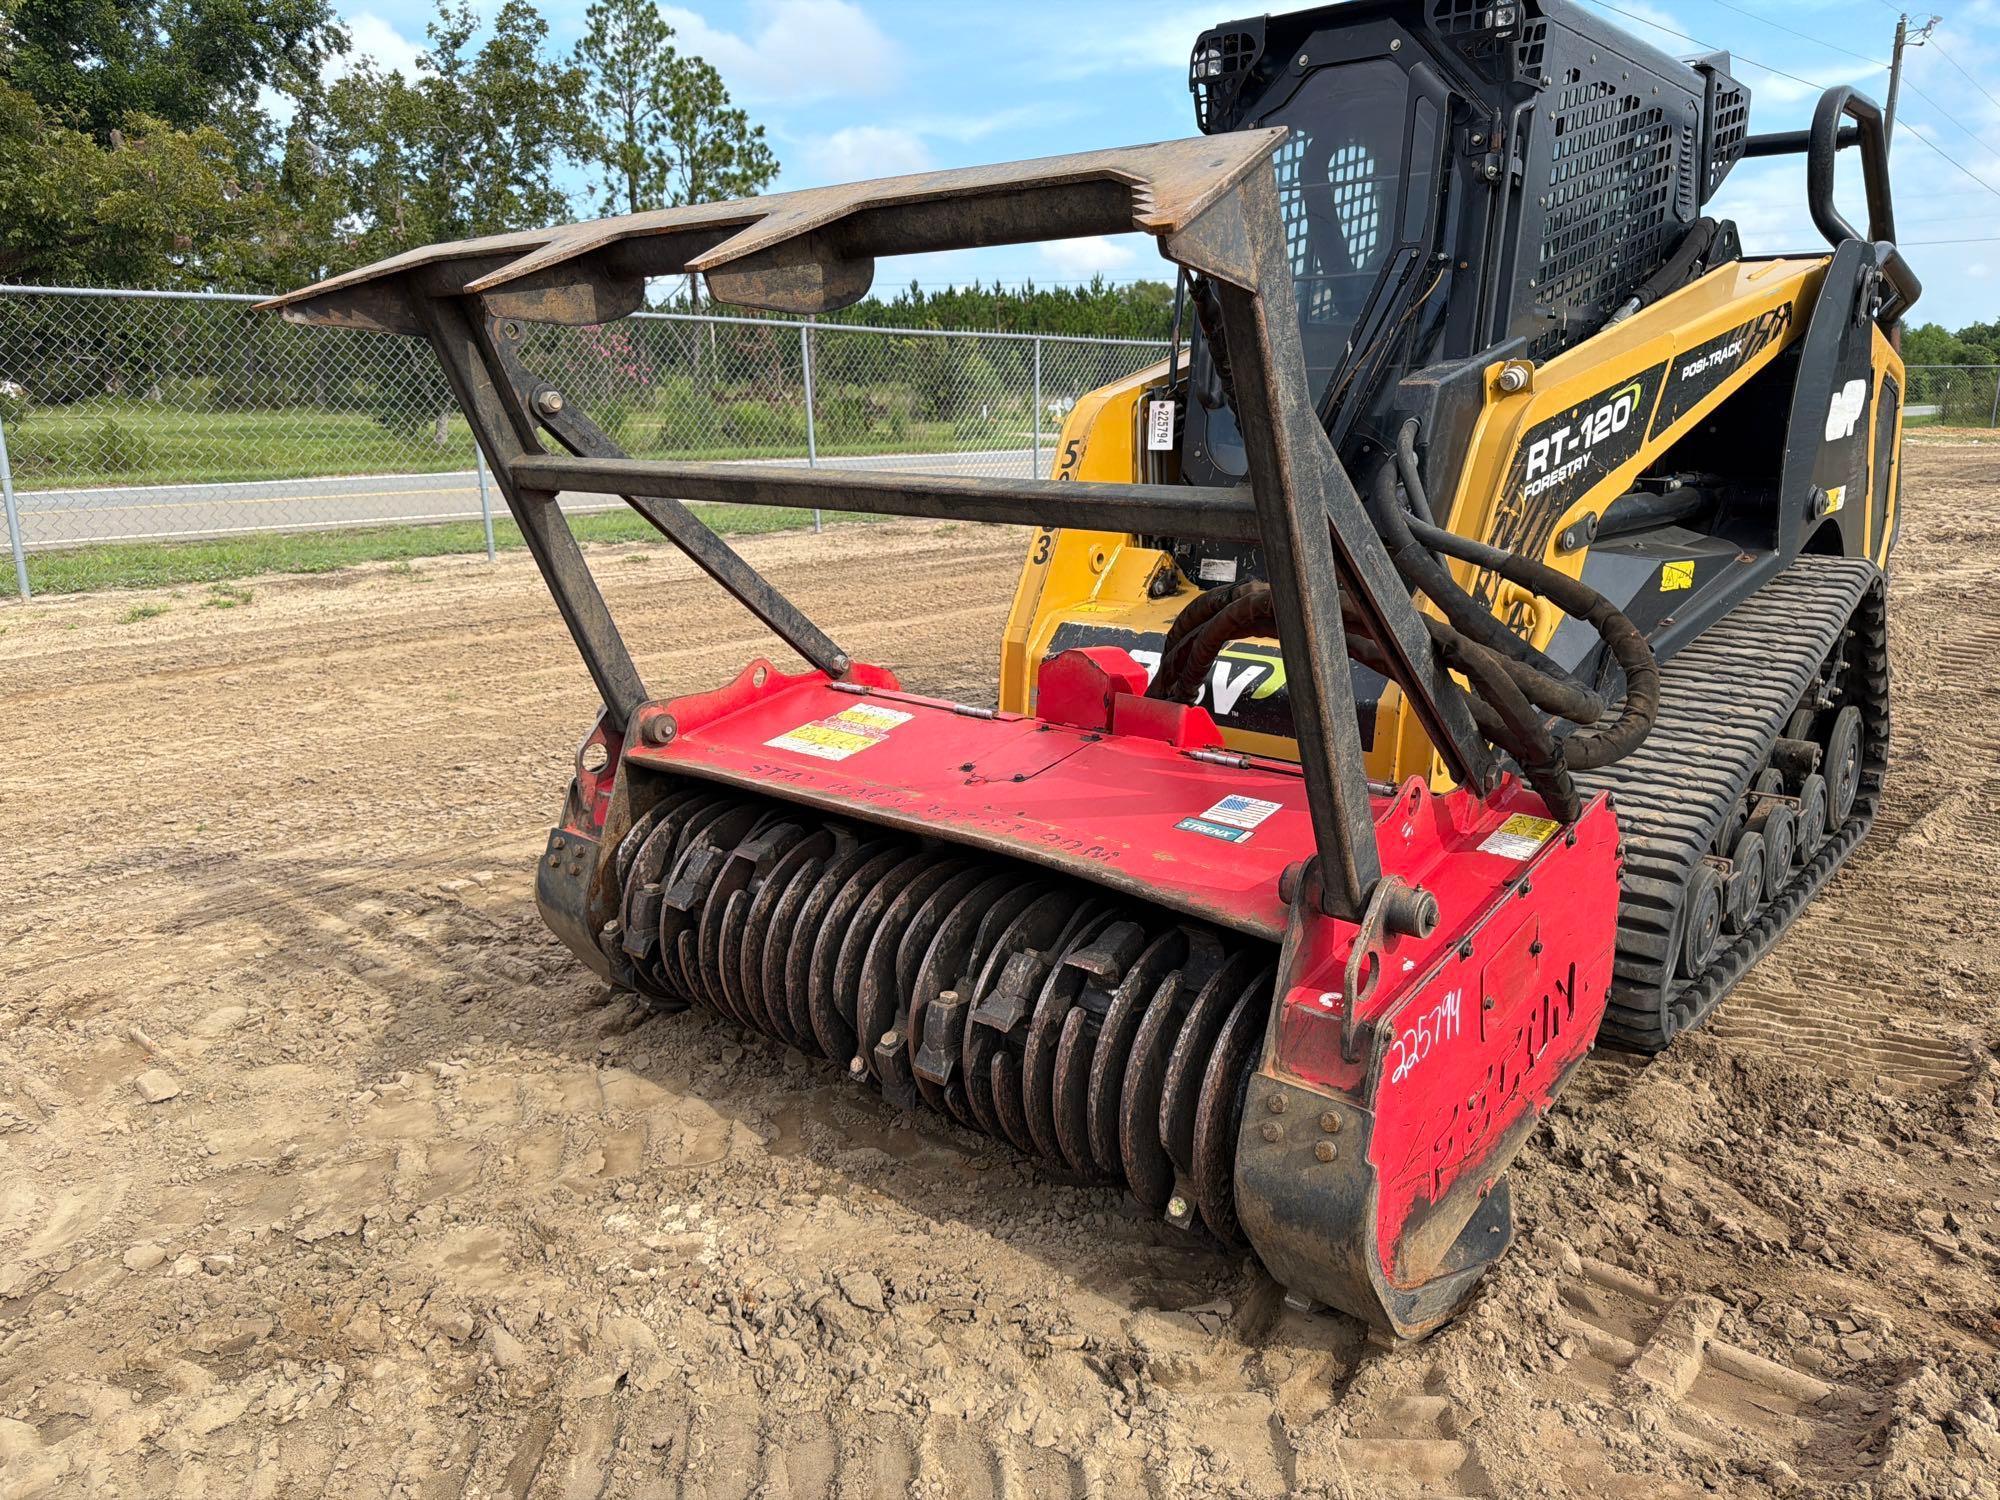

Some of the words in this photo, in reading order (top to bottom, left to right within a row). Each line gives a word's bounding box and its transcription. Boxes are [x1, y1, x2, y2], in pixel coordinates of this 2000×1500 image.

[1681, 340, 1742, 381] POSI-TRACK
[1156, 410, 1169, 443] 225794
[1525, 394, 1631, 481] RT-120
[1523, 451, 1592, 501] FORESTRY
[1180, 821, 1232, 838] STRENX
[1391, 987, 1462, 1084] 225794
